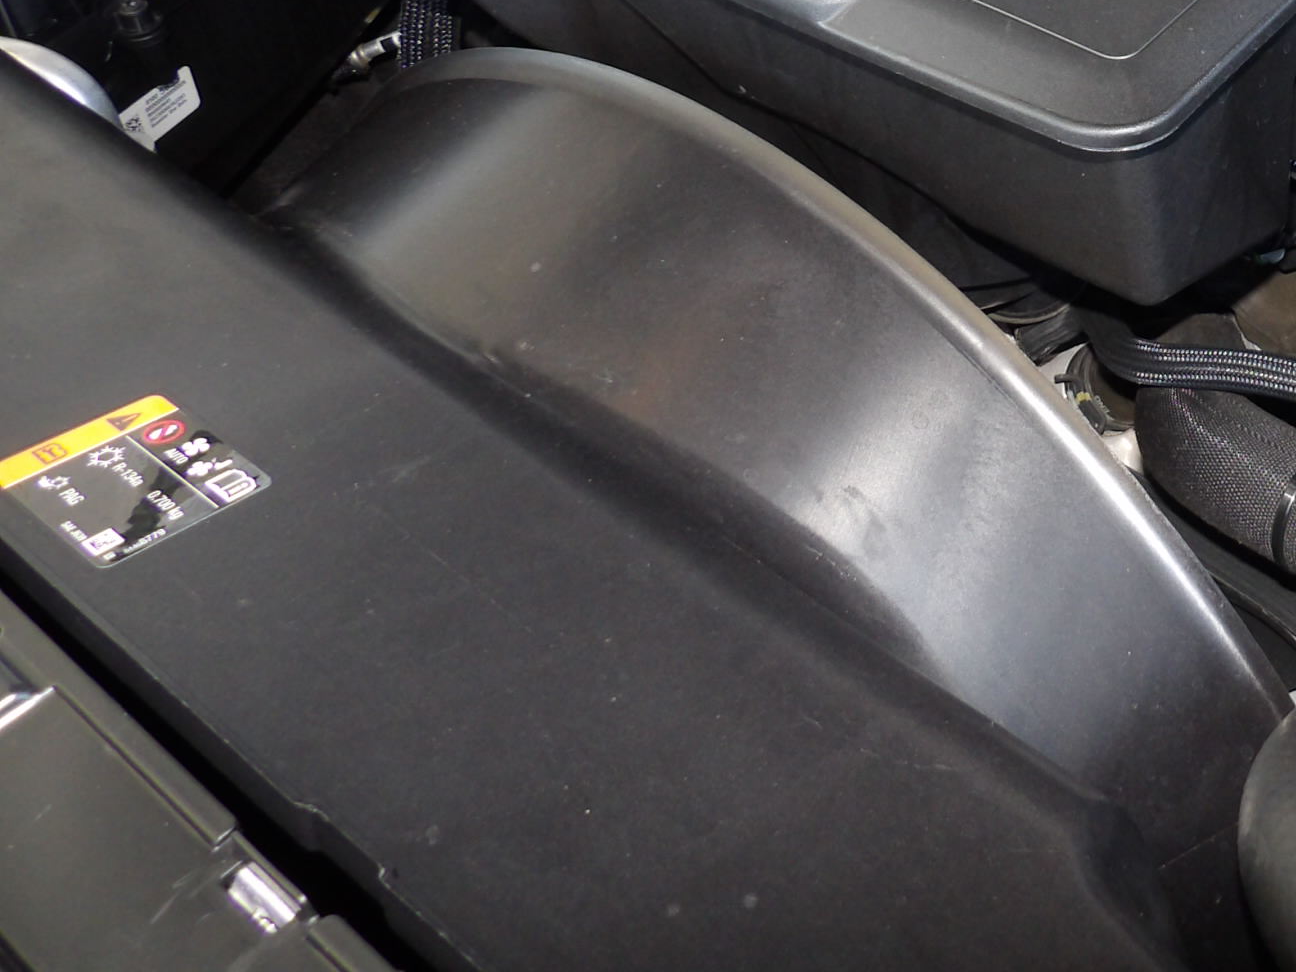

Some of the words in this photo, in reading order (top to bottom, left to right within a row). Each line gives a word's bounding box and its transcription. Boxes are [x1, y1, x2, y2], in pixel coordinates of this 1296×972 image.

[164, 448, 189, 465] AUTO
[112, 462, 144, 488] R-134a
[58, 488, 85, 506] PAG
[147, 490, 176, 511] 0.700
[167, 506, 184, 521] kg
